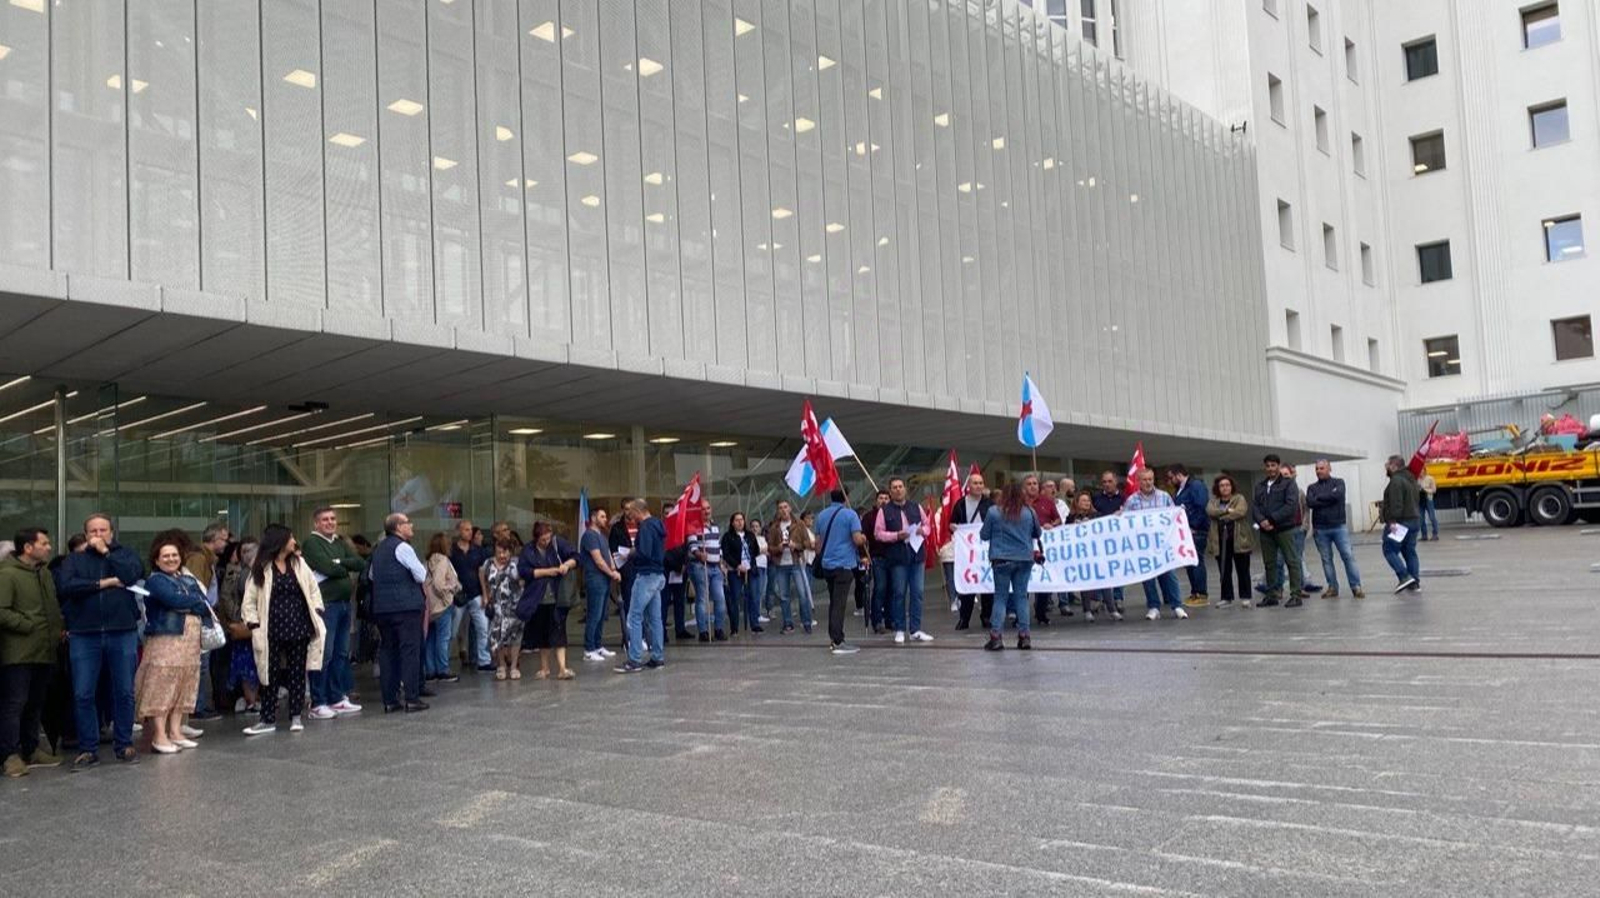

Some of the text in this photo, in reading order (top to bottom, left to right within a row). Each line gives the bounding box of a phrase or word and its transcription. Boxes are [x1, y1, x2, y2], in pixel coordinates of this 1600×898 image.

[1446, 456, 1587, 479] DONIZ
[1043, 511, 1171, 544] RECORTES
[1045, 531, 1165, 563] GURIDADE
[1064, 545, 1175, 584] CULPABLE
